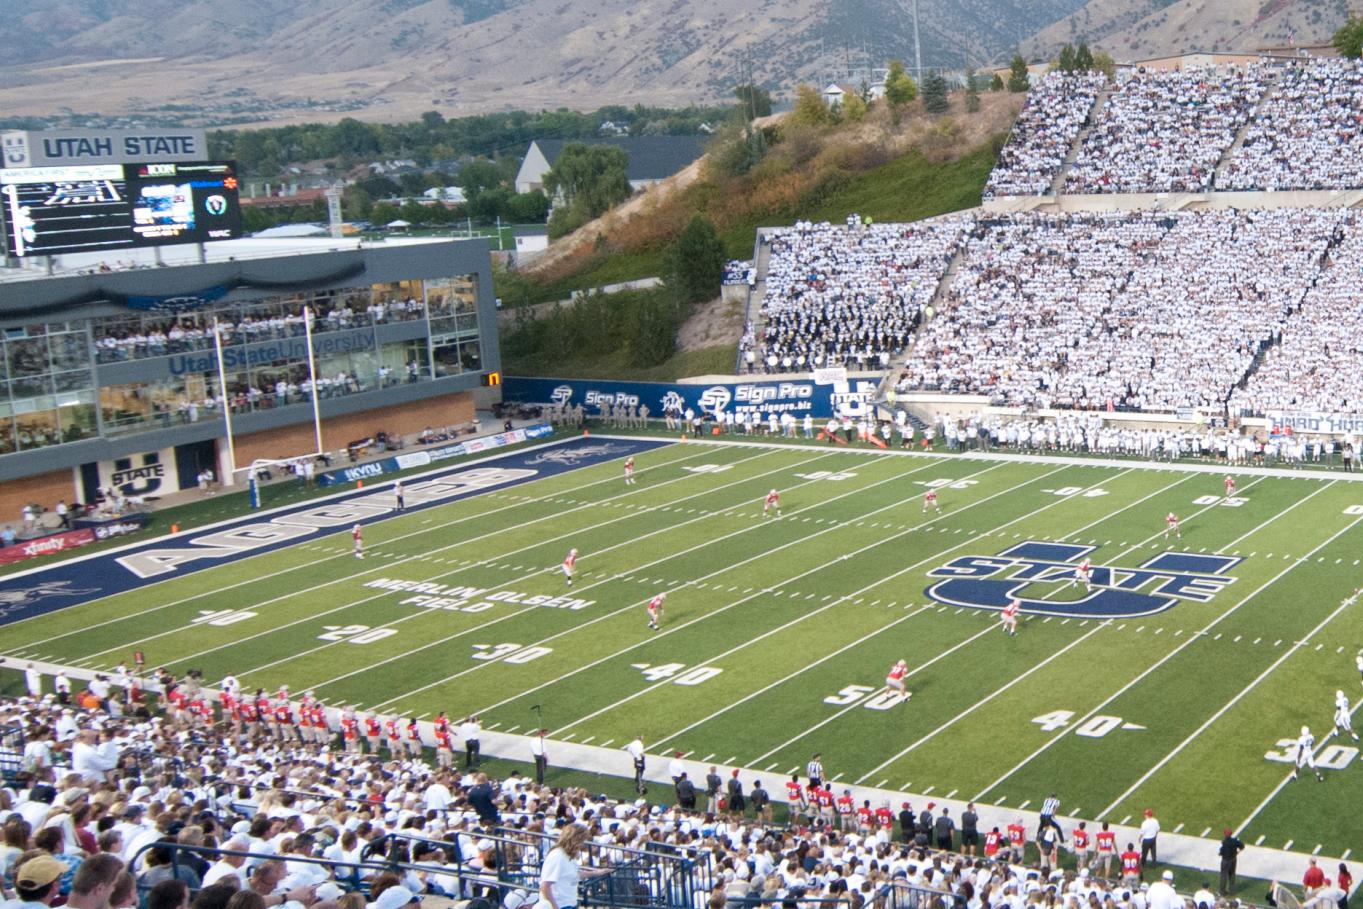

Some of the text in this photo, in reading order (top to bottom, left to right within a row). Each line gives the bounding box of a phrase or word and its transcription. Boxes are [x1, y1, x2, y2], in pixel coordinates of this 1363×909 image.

[44, 135, 196, 158] UTAH STATE
[279, 333, 375, 357] Unversity
[585, 391, 639, 408] Sign Pro
[735, 383, 812, 403] Sign Pro
[735, 401, 812, 412] www.signpro.biz
[112, 464, 165, 486] STATE
[925, 555, 1239, 603] STATE
[362, 577, 597, 611] MERLIN OLSEN
[399, 595, 494, 613] FIELD
[190, 609, 259, 626] 10
[316, 624, 399, 644] 20
[471, 643, 554, 664] 30
[641, 663, 723, 686] 40
[823, 684, 912, 710] 50
[1031, 709, 1122, 738] 40
[1263, 738, 1360, 770] 30
